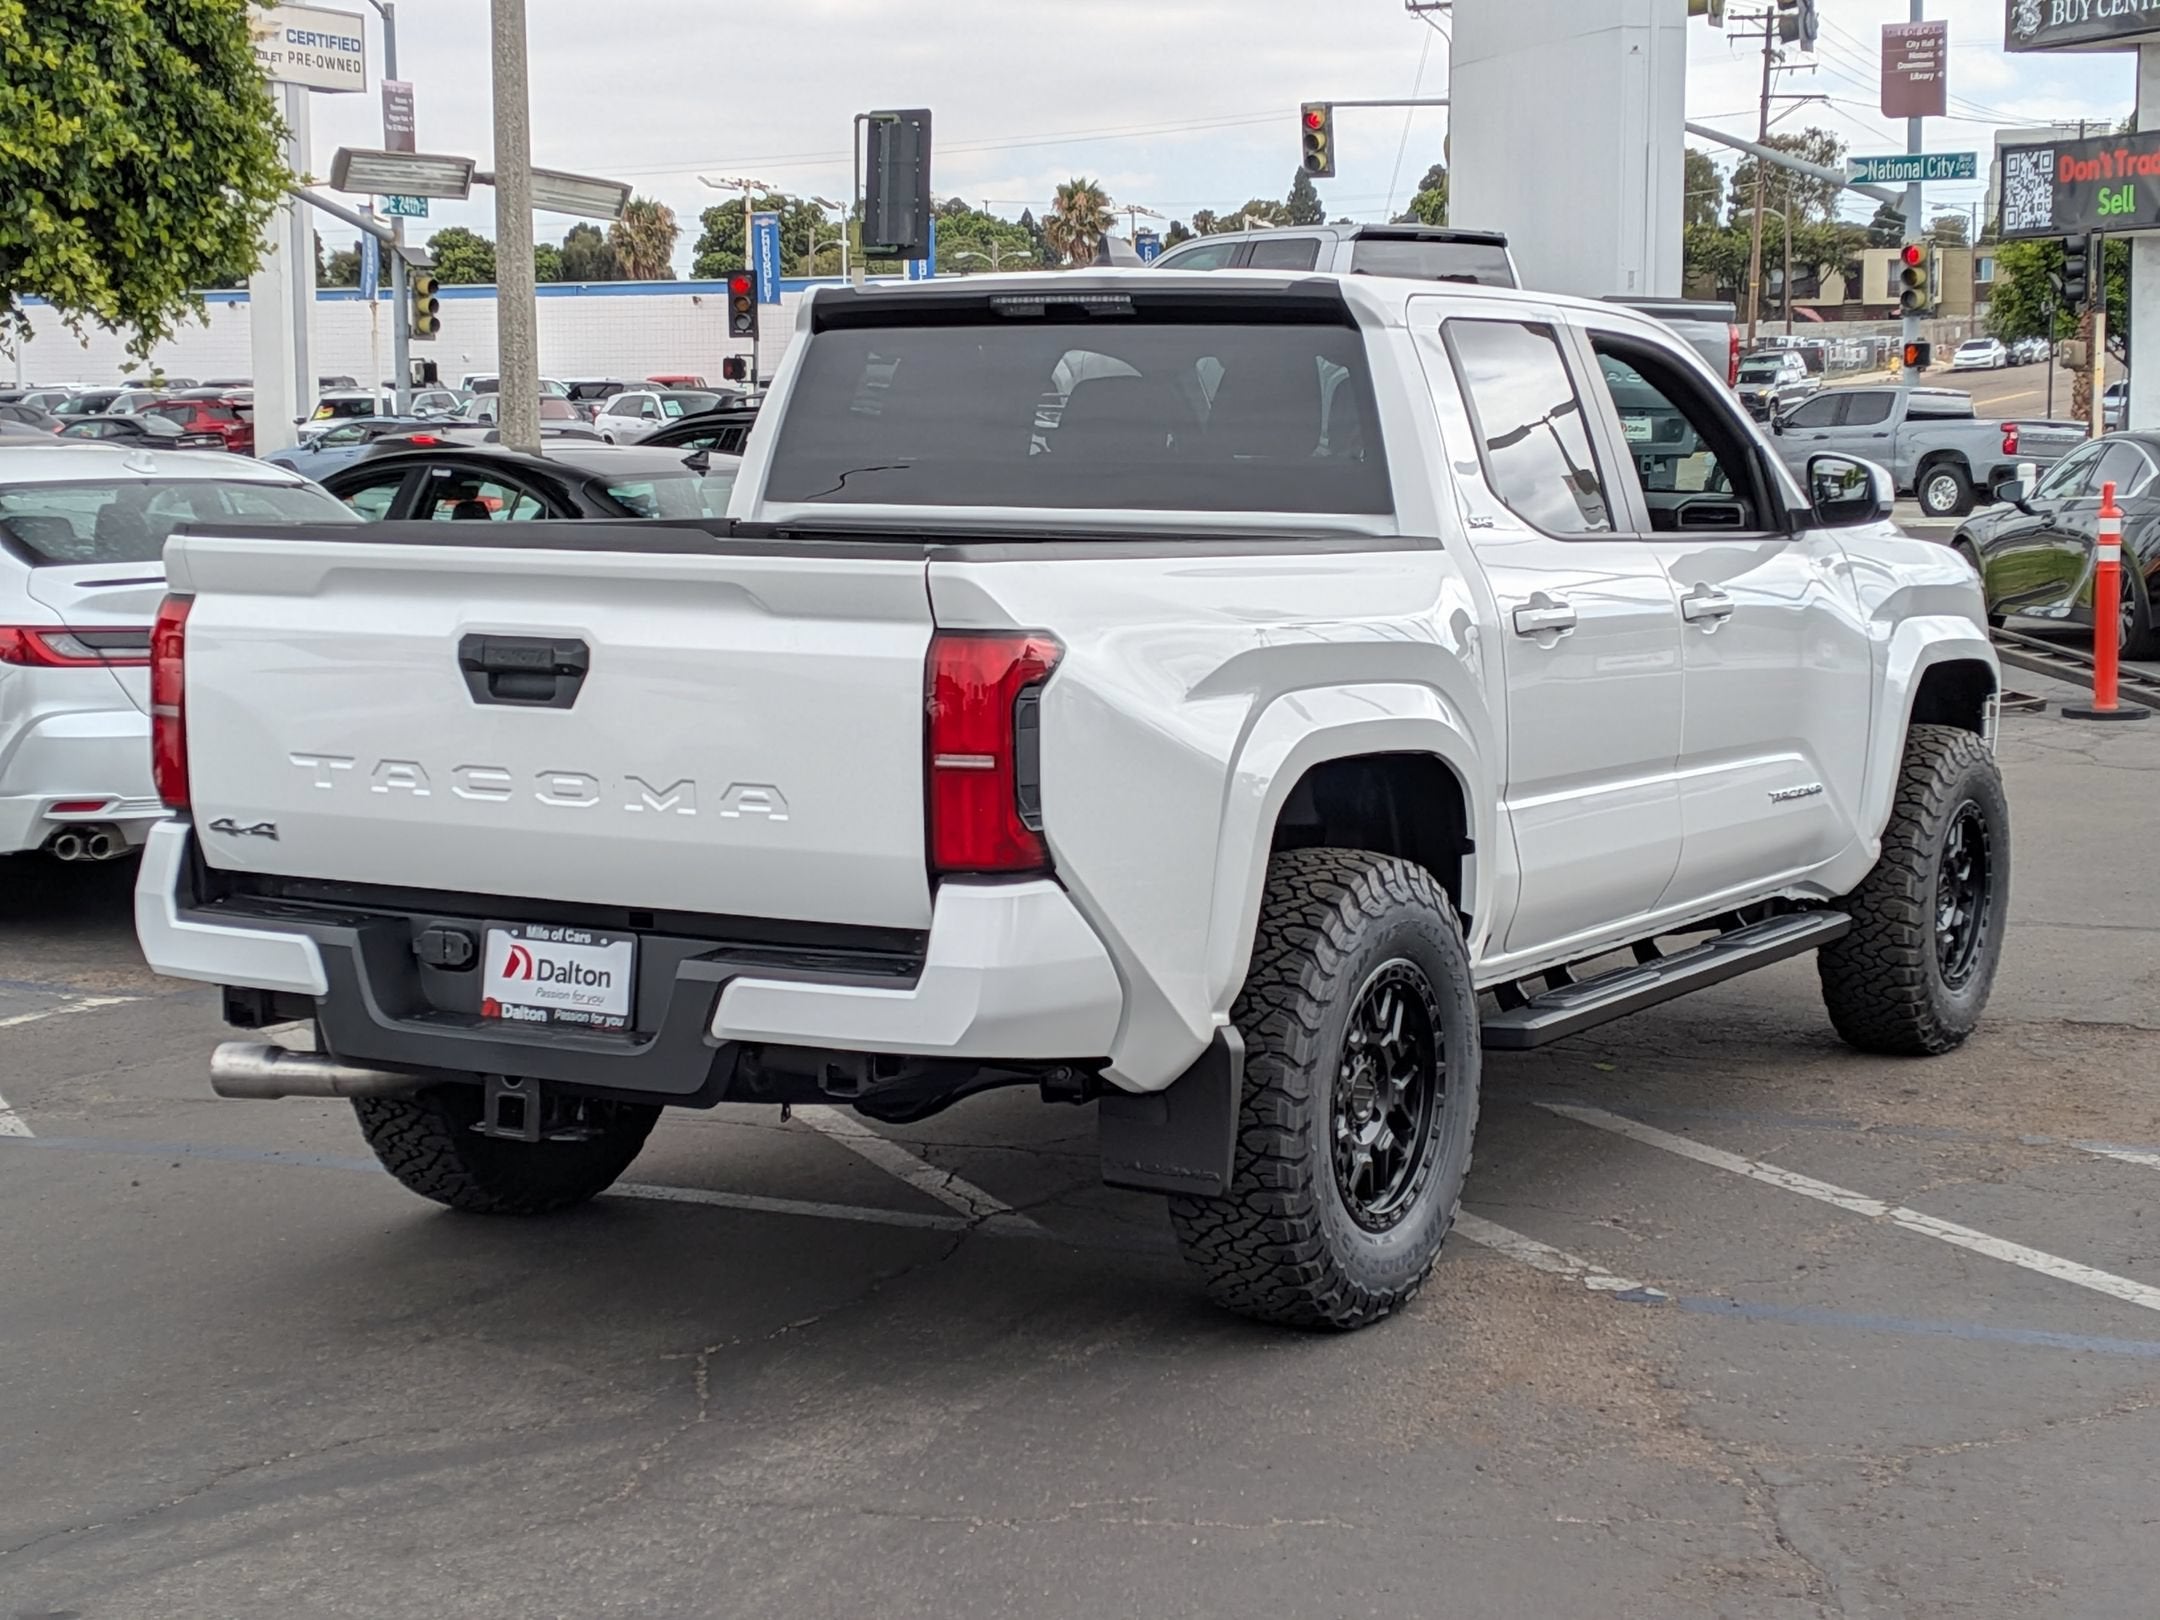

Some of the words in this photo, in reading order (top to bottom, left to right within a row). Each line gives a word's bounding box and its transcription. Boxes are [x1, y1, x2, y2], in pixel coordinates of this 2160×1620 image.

[2050, 0, 2091, 26] BUY
[286, 28, 361, 53] CERTIFIED
[1906, 40, 1920, 49] City
[288, 51, 361, 73] PRE-OWNED
[1910, 72, 1935, 81] Library
[1867, 158, 1924, 181] National
[1927, 156, 1956, 178] City
[2059, 151, 2112, 183] Don't
[389, 195, 398, 213] E
[2097, 184, 2136, 216] Sell
[289, 752, 789, 821] TACOMA
[526, 924, 549, 940] Mile
[550, 928, 564, 942] of
[564, 929, 592, 944] Cars
[536, 958, 611, 988] Dalton
[535, 986, 571, 1000] Passion
[572, 990, 585, 1001] for
[586, 993, 605, 1005] you
[502, 1003, 548, 1022] Dalton
[553, 1008, 589, 1023] Passion
[590, 1013, 604, 1025] for
[604, 1016, 625, 1028] you
